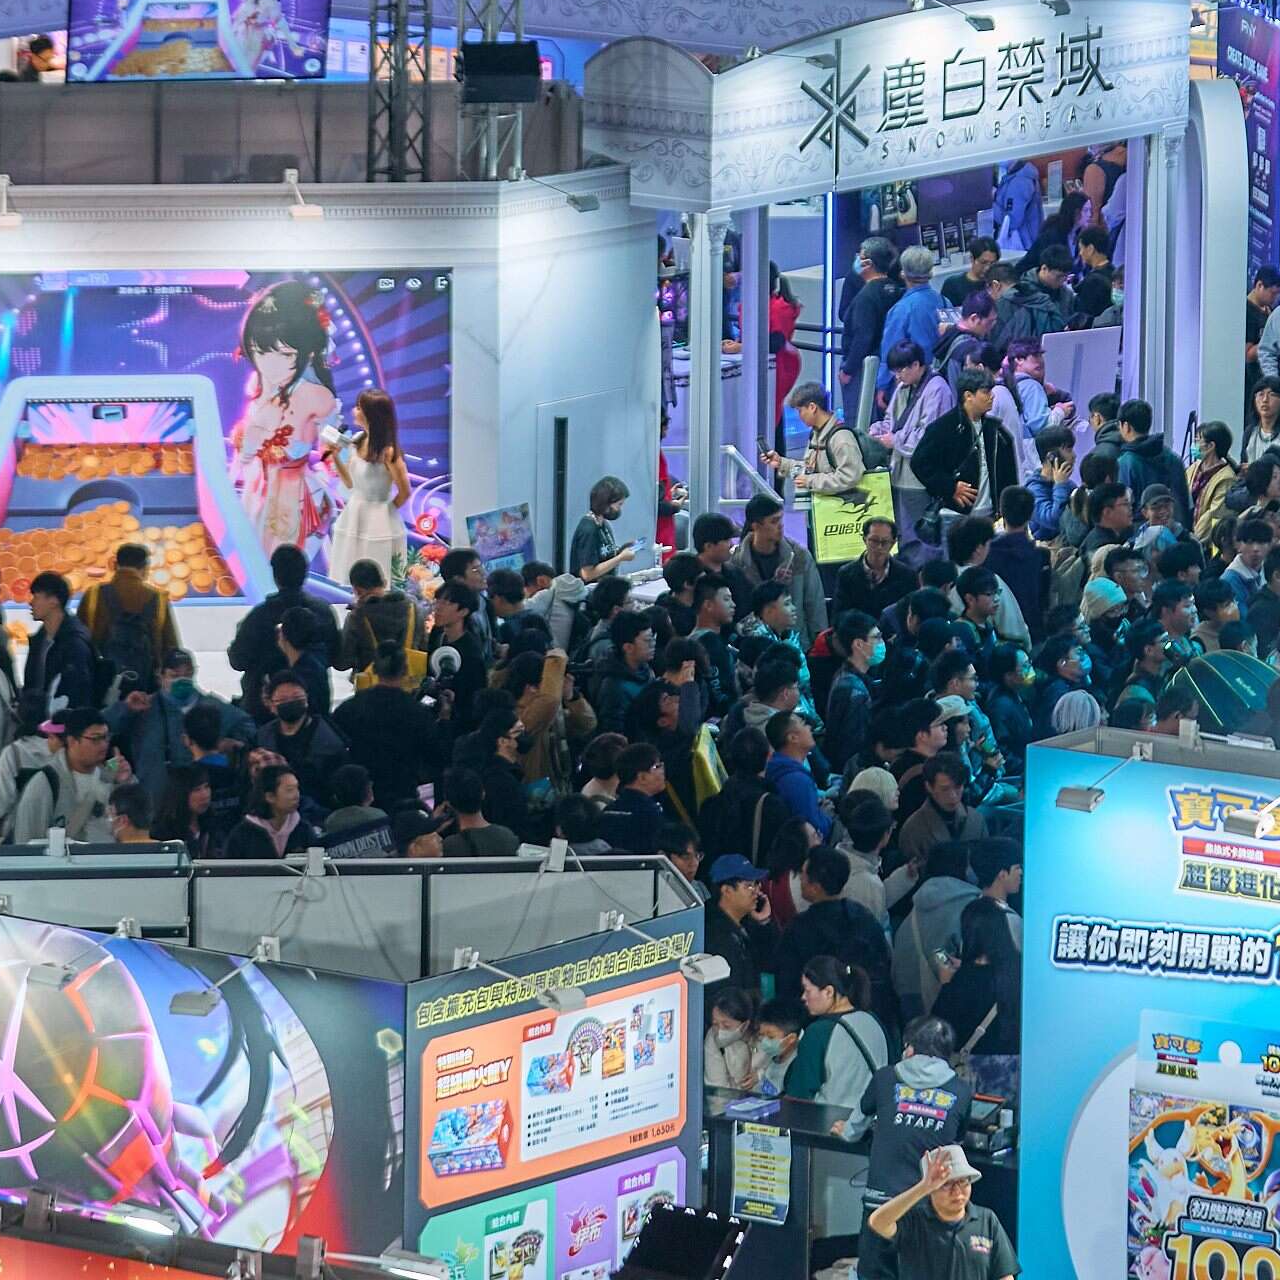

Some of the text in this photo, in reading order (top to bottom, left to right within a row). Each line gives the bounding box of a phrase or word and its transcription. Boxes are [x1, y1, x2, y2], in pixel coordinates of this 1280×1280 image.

[875, 21, 1115, 134] 塵白禁域
[881, 101, 1105, 160] SNOWBREAK
[894, 1112, 945, 1132] STAFF
